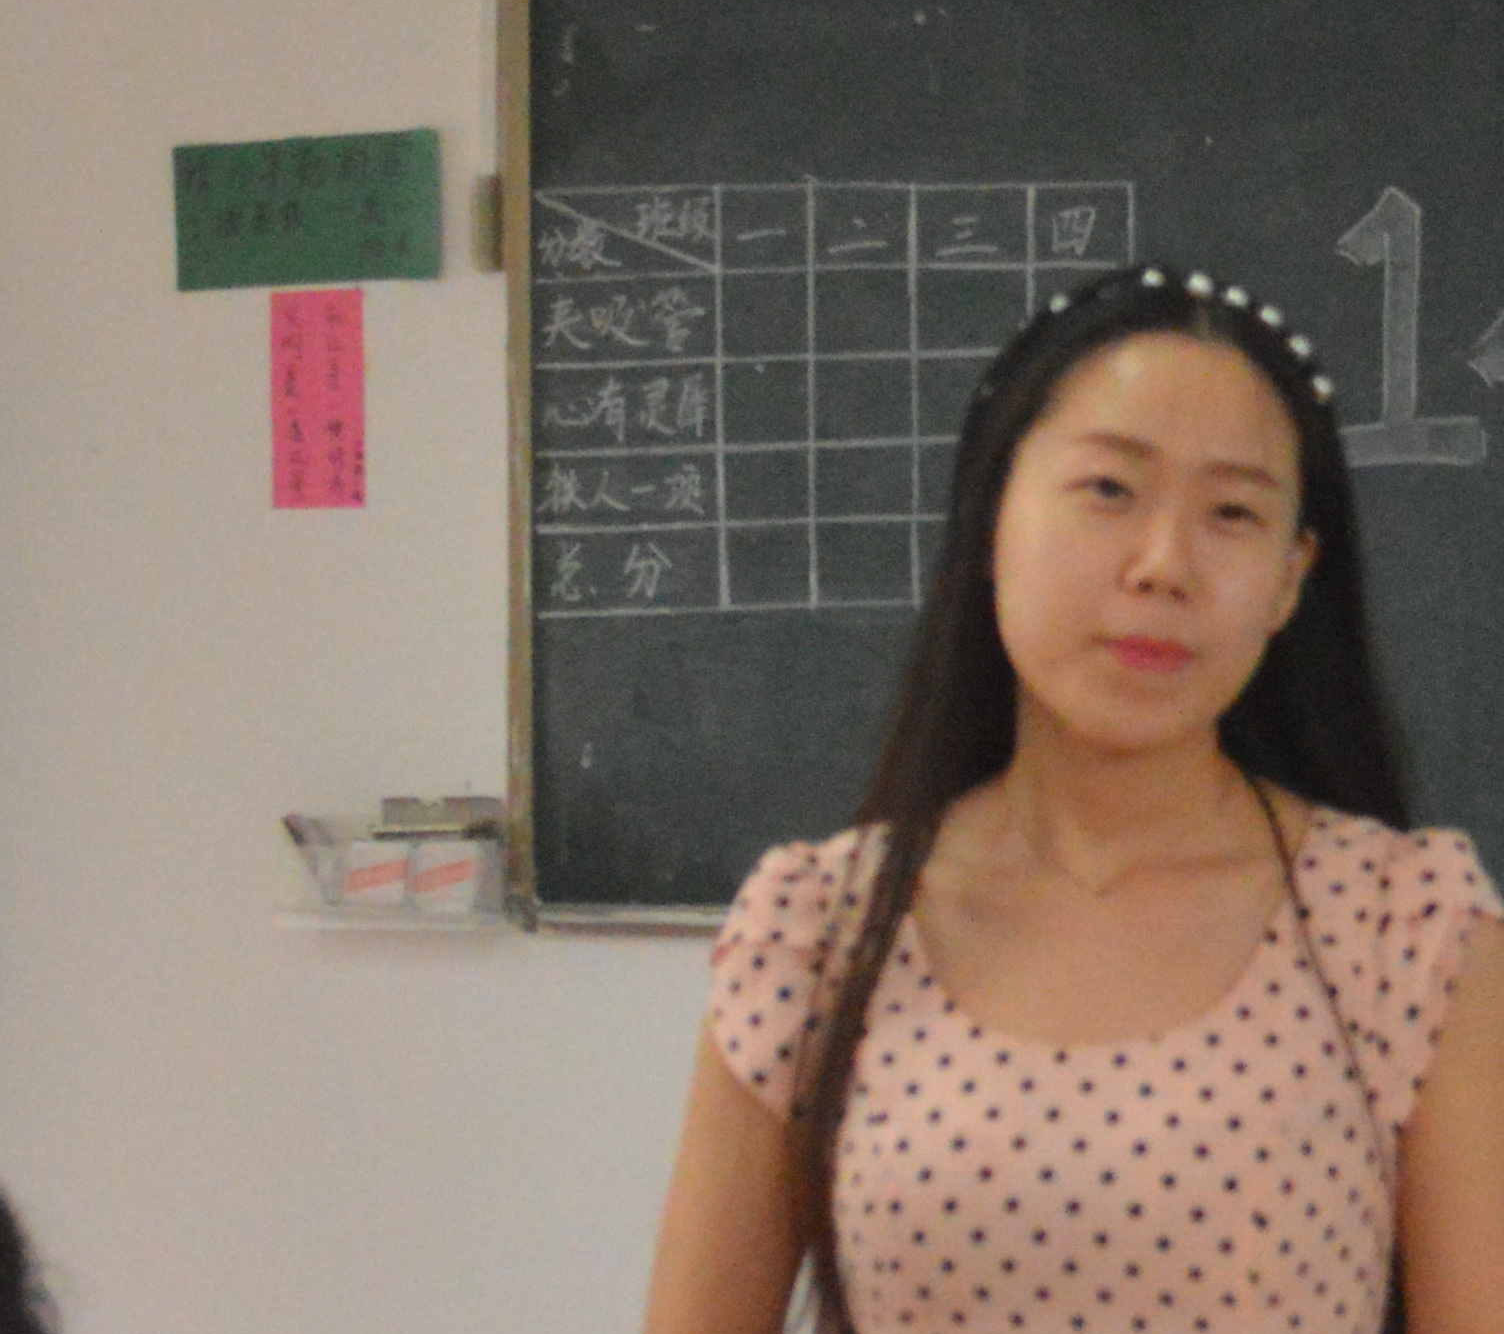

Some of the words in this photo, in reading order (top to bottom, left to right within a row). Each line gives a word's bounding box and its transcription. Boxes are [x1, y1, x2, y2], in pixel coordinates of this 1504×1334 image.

[737, 227, 788, 242] 一
[826, 215, 888, 255] 二
[935, 215, 998, 257] 三
[1051, 205, 1096, 256] 四
[549, 539, 674, 603] 总分
